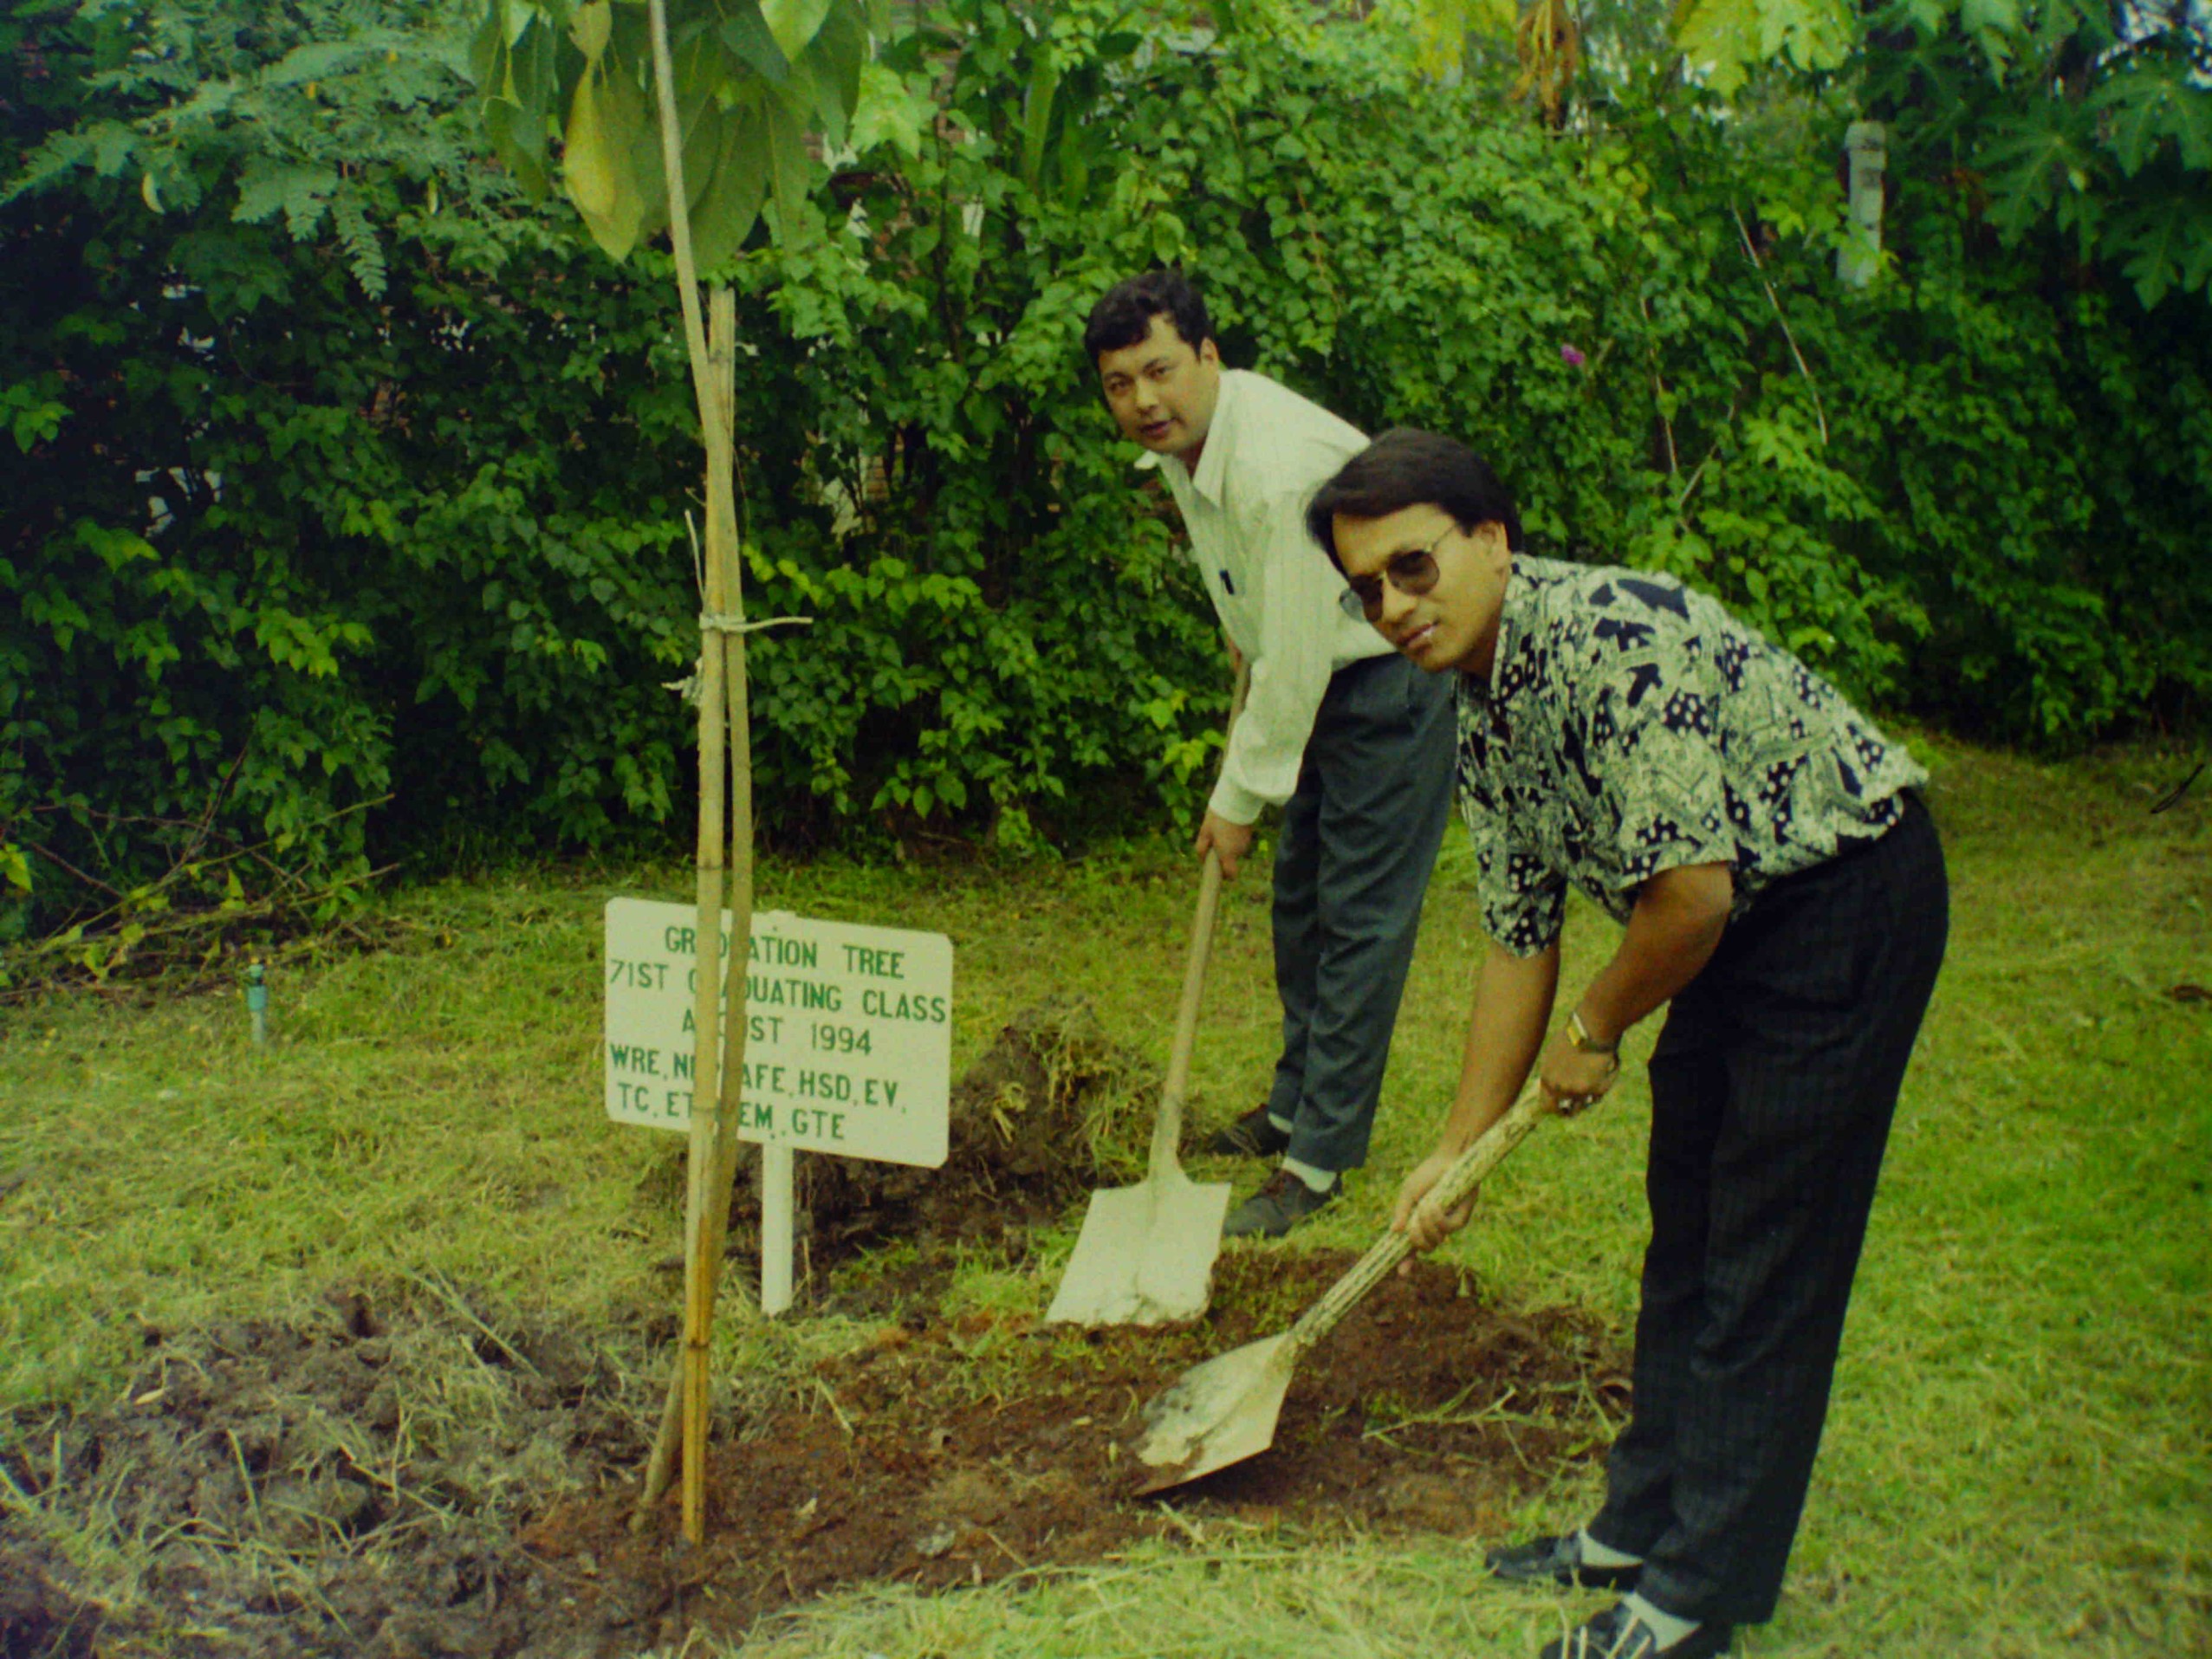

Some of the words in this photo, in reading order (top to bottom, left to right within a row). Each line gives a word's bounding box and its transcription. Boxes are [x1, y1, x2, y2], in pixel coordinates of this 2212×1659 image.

[665, 925, 818, 968] GRDATION
[842, 943, 905, 979] TREE
[609, 959, 669, 990] 71ST
[862, 989, 946, 1023] CLASS
[812, 1022, 872, 1056] 1994
